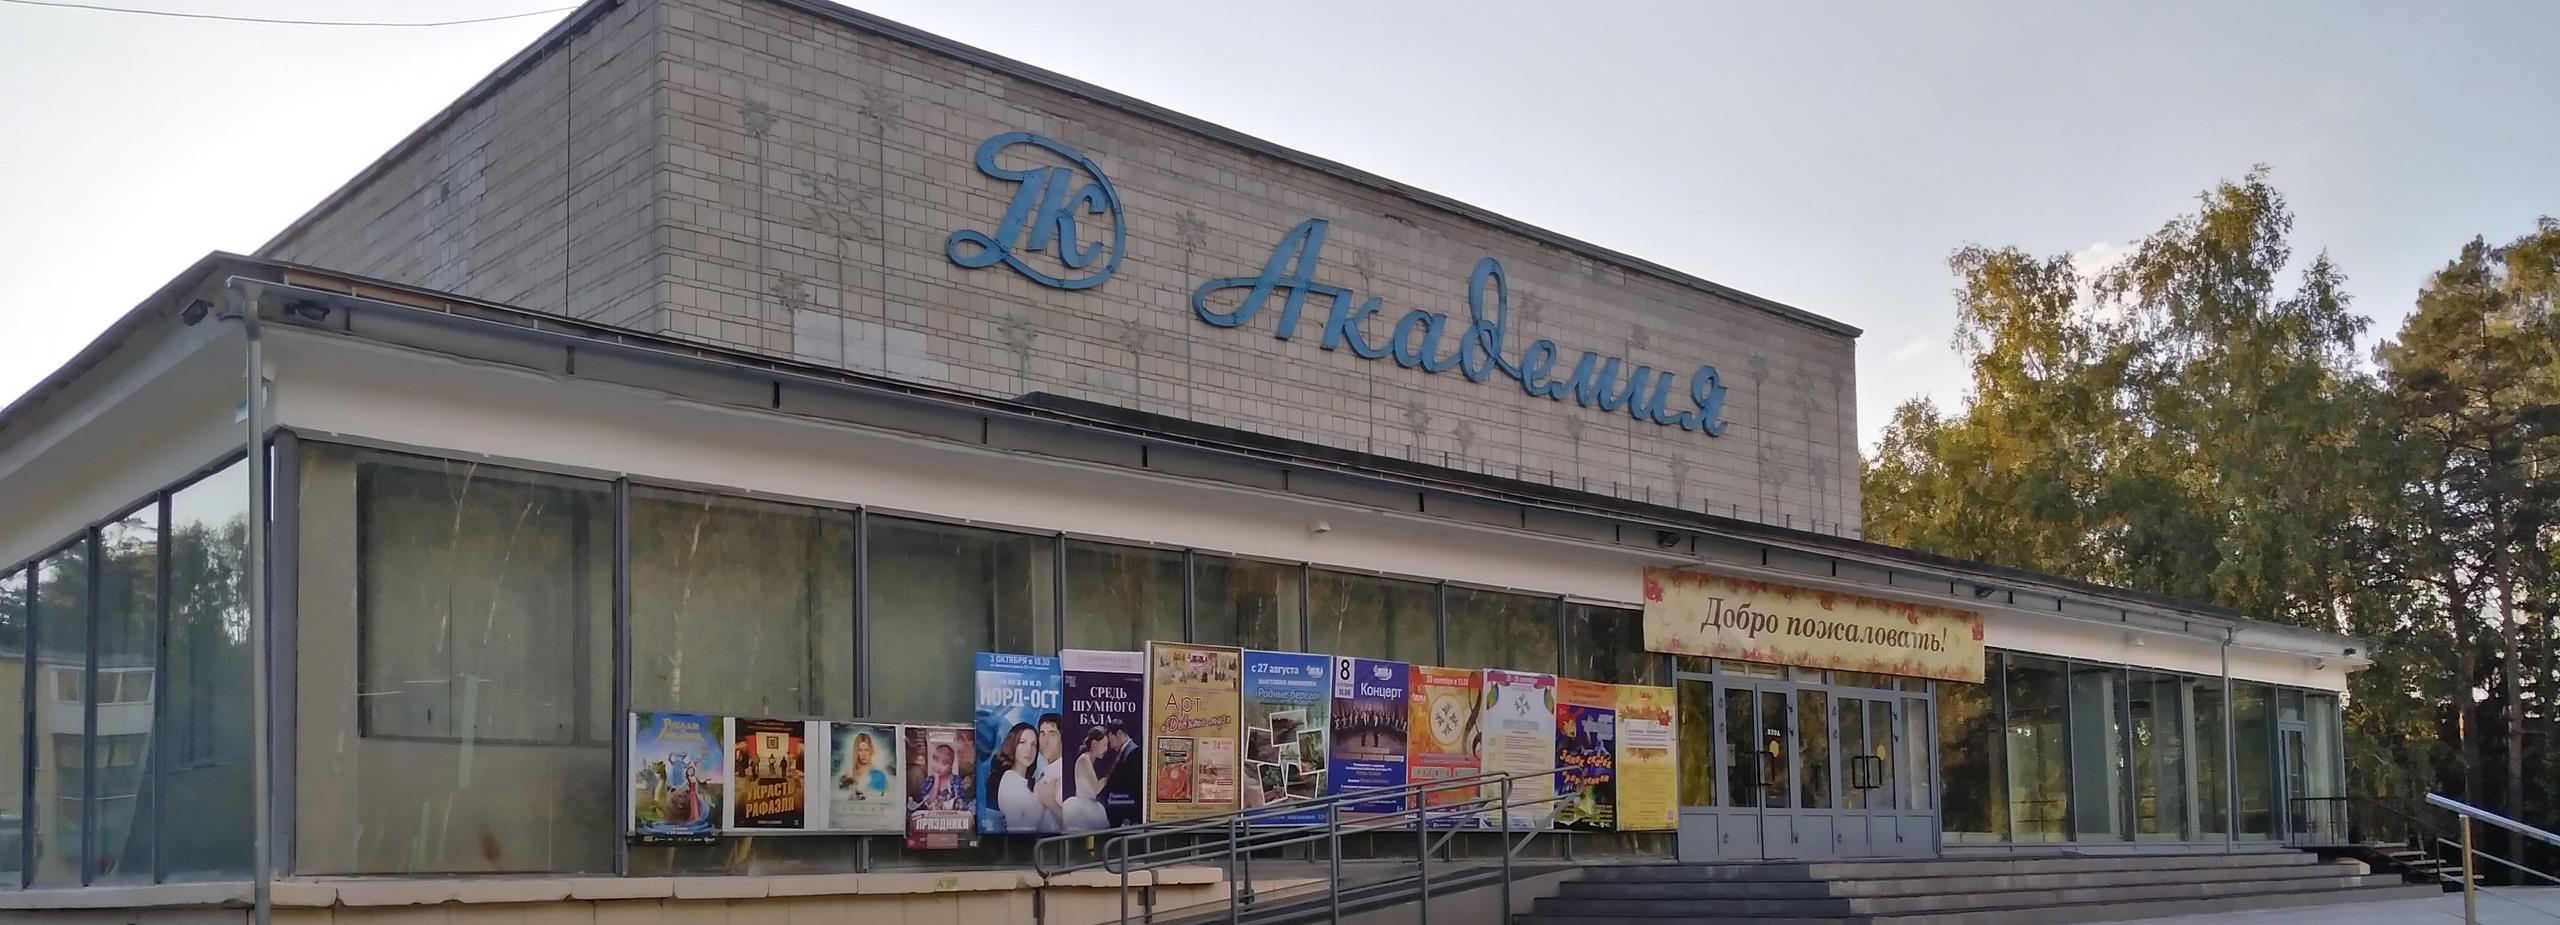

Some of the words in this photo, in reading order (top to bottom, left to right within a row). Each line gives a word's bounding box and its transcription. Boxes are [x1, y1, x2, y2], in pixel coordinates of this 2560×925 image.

[946, 131, 1126, 291] ДК
[1192, 218, 1727, 439] Академия
[1700, 597, 1779, 638] Добро
[1786, 616, 1948, 653] пожаловать!
[995, 655, 1027, 666] ОКТЯБРЯ
[1251, 665, 1256, 673] с
[1257, 663, 1268, 673] 27
[1269, 666, 1299, 676] августа
[1340, 659, 1351, 681] 8
[980, 685, 1059, 709] НОРД-ОСТ
[1090, 686, 1127, 700] СРЕДЬ
[1360, 682, 1403, 700] Концерт
[1072, 700, 1136, 713] ШУМНОГО
[1165, 692, 1201, 716] Арт
[746, 781, 796, 801] УКРАСТЬ
[916, 817, 969, 831] ПРАЗДНИКИ
